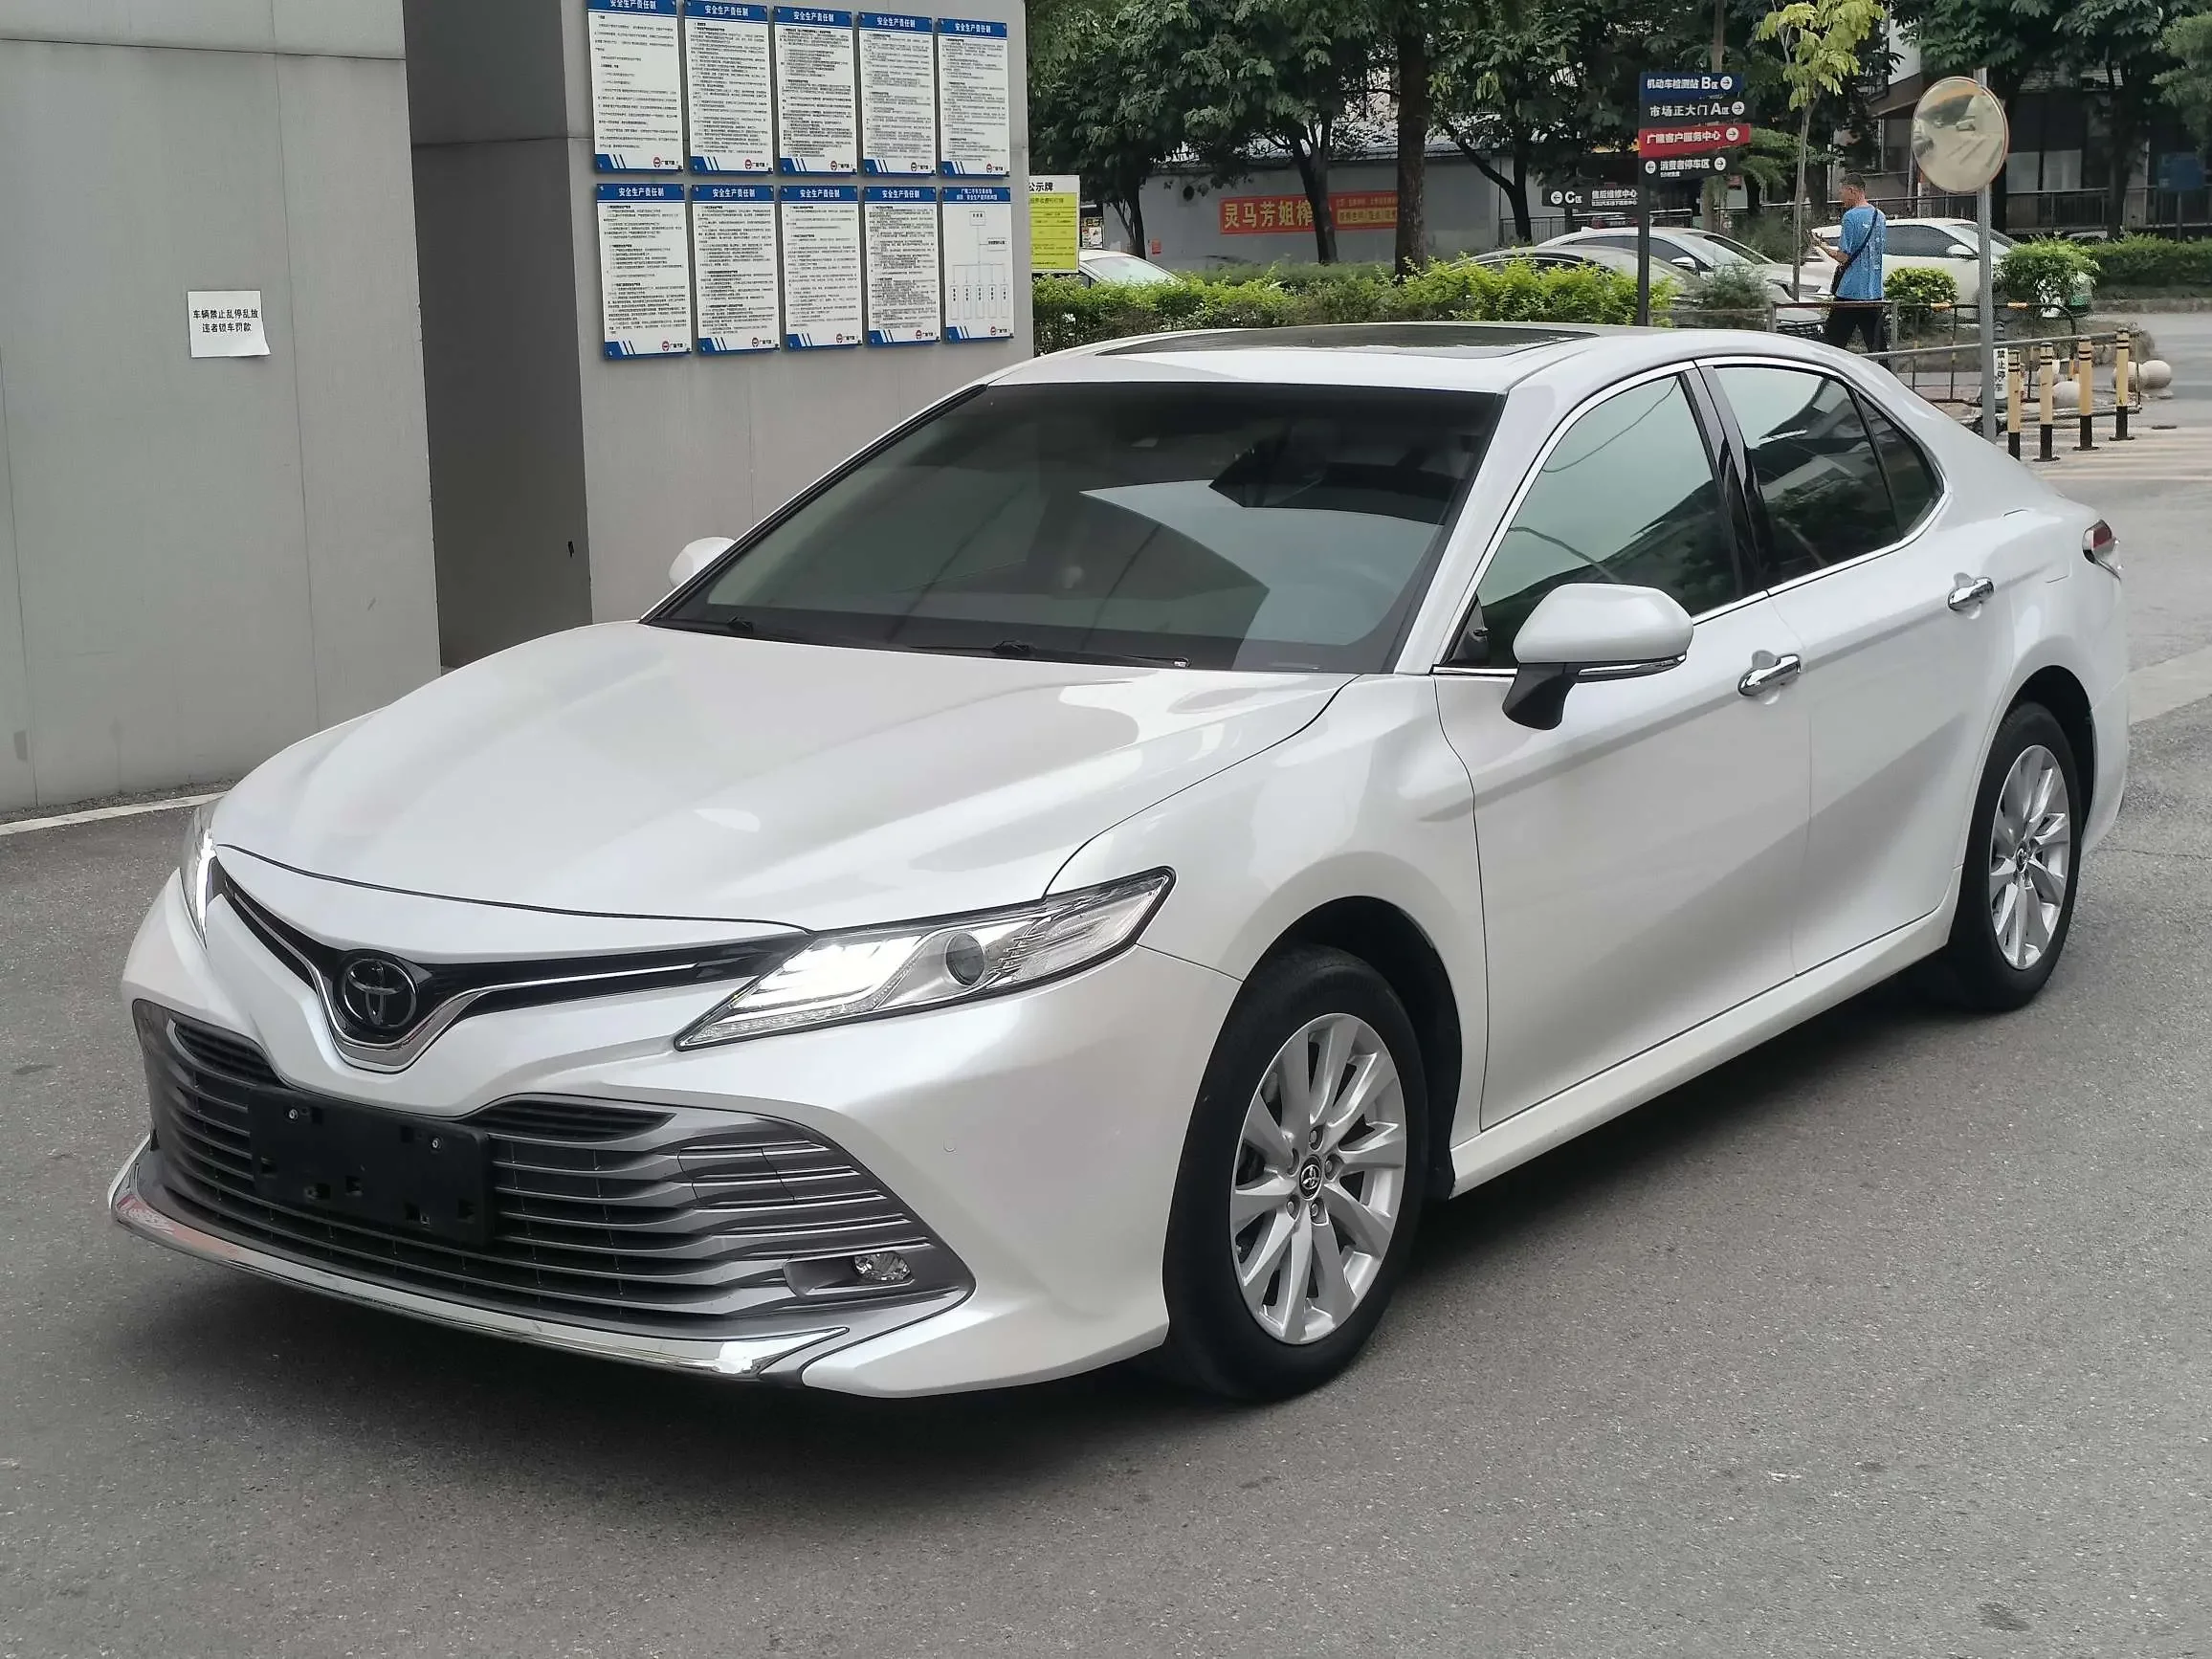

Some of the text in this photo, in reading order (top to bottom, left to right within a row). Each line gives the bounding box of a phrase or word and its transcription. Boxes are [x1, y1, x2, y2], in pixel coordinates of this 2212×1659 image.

[609, 0, 656, 10] 安全生产责任制
[704, 5, 749, 17] 安全生产责任制
[793, 11, 834, 23] 安全生产责任制
[876, 16, 916, 28] 安全生产责任制
[955, 23, 991, 33] 安全生产责任制
[1649, 103, 1708, 118] 市场正大门
[1660, 159, 1711, 172] 消费者停车区
[618, 187, 665, 198] 安全生产责任制
[712, 188, 756, 198] 安全生产责任制
[799, 188, 840, 199] 安全生产责任制
[881, 188, 920, 199] 安全生产责任制
[1225, 200, 1314, 229] 灵马芳姐榨
[193, 309, 258, 320] 车辆禁止乱停乱放
[202, 321, 252, 333] 违者锁车罚款
